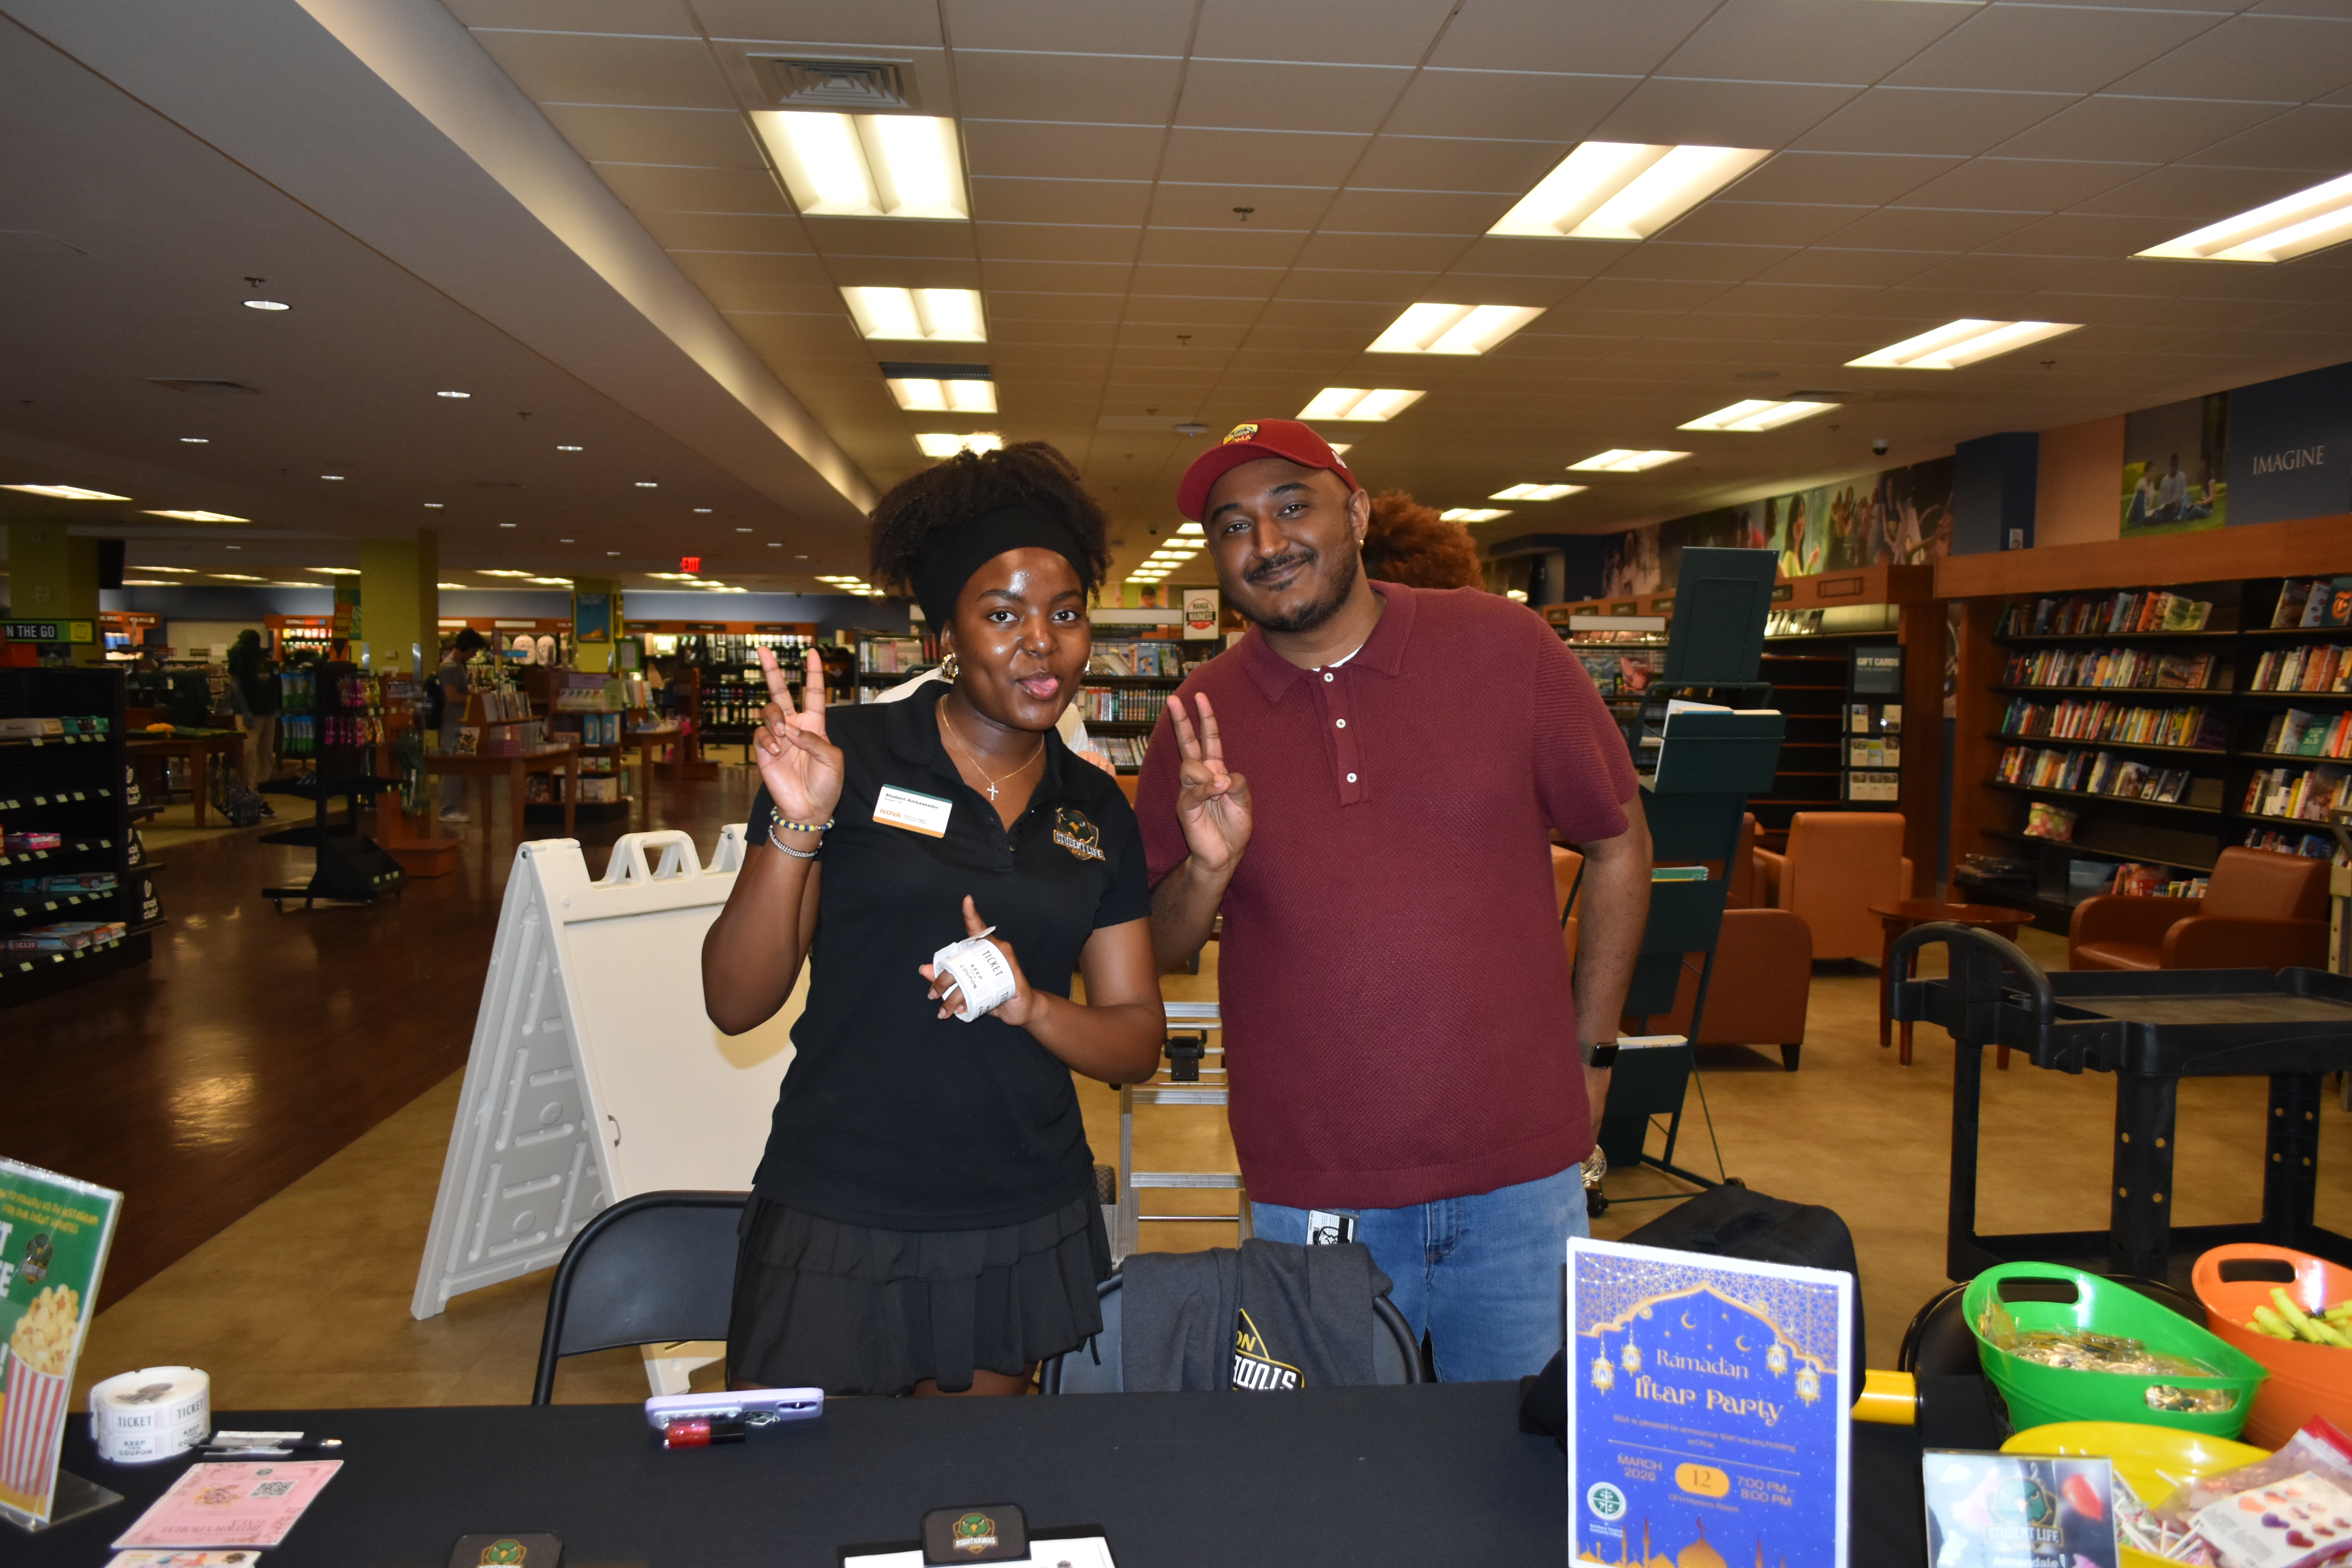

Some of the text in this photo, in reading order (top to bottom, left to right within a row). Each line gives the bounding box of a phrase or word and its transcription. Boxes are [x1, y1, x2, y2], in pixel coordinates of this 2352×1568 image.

[2252, 445, 2325, 474] IMAGINE
[682, 557, 700, 571] EXIT
[1189, 612, 1213, 620] MADNESS
[17, 625, 37, 637] THE
[41, 626, 54, 637] GO
[1875, 658, 1899, 666] CARDS
[886, 793, 939, 809] Student Ambassador
[880, 808, 901, 818] NOVA
[1056, 832, 1086, 852] STUDENT
[1086, 846, 1103, 858] LIFE
[982, 950, 1004, 976] TICKET
[960, 964, 978, 989] COUPON
[970, 964, 983, 980] KEEP
[1657, 1348, 1749, 1379] Ramadan
[177, 1398, 203, 1418] TICKET
[1635, 1374, 1784, 1427] Iftar Party
[118, 1416, 152, 1427] TICKET
[183, 1423, 200, 1436] KEEP
[1639, 1419, 1669, 1430] pleased
[1681, 1427, 1718, 1438] announce
[1765, 1440, 1796, 1453] holding
[1618, 1454, 1662, 1471] MARCH
[1624, 1467, 1657, 1482] 2026
[1693, 1469, 1711, 1488] 12
[1737, 1475, 1764, 1490] 7:00
[1767, 1481, 1787, 1494] PM
[1741, 1488, 1792, 1506] 8:00 PM
[1716, 1502, 1739, 1513] Room
[1987, 1526, 2034, 1540] STUDENT
[956, 1536, 996, 1547] NIGHTHAWKS
[1993, 1555, 2059, 1568] Annandale
